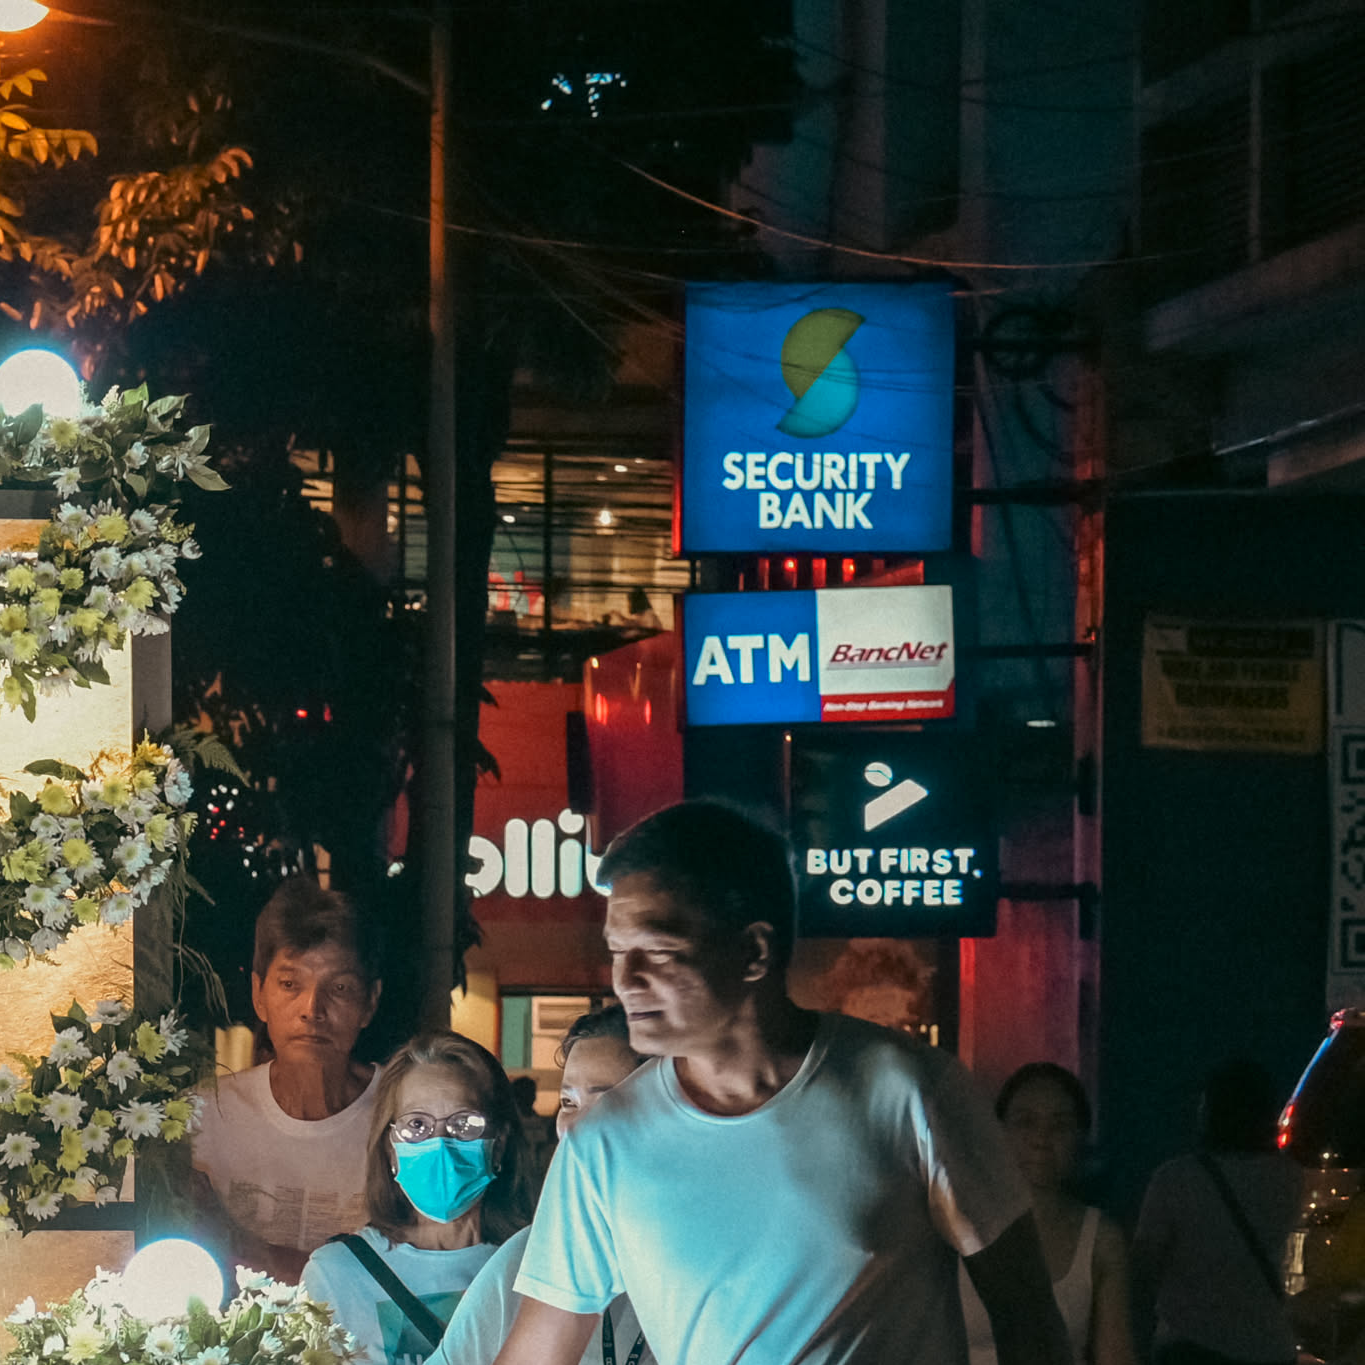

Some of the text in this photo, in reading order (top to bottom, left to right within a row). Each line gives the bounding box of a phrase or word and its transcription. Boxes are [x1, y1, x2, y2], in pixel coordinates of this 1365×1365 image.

[722, 452, 910, 490] SECURITY
[759, 492, 873, 529] BANK
[692, 633, 811, 686] ATM
[830, 641, 948, 663] BancNet
[806, 848, 874, 875] BUT
[830, 879, 964, 906] COFFEE
